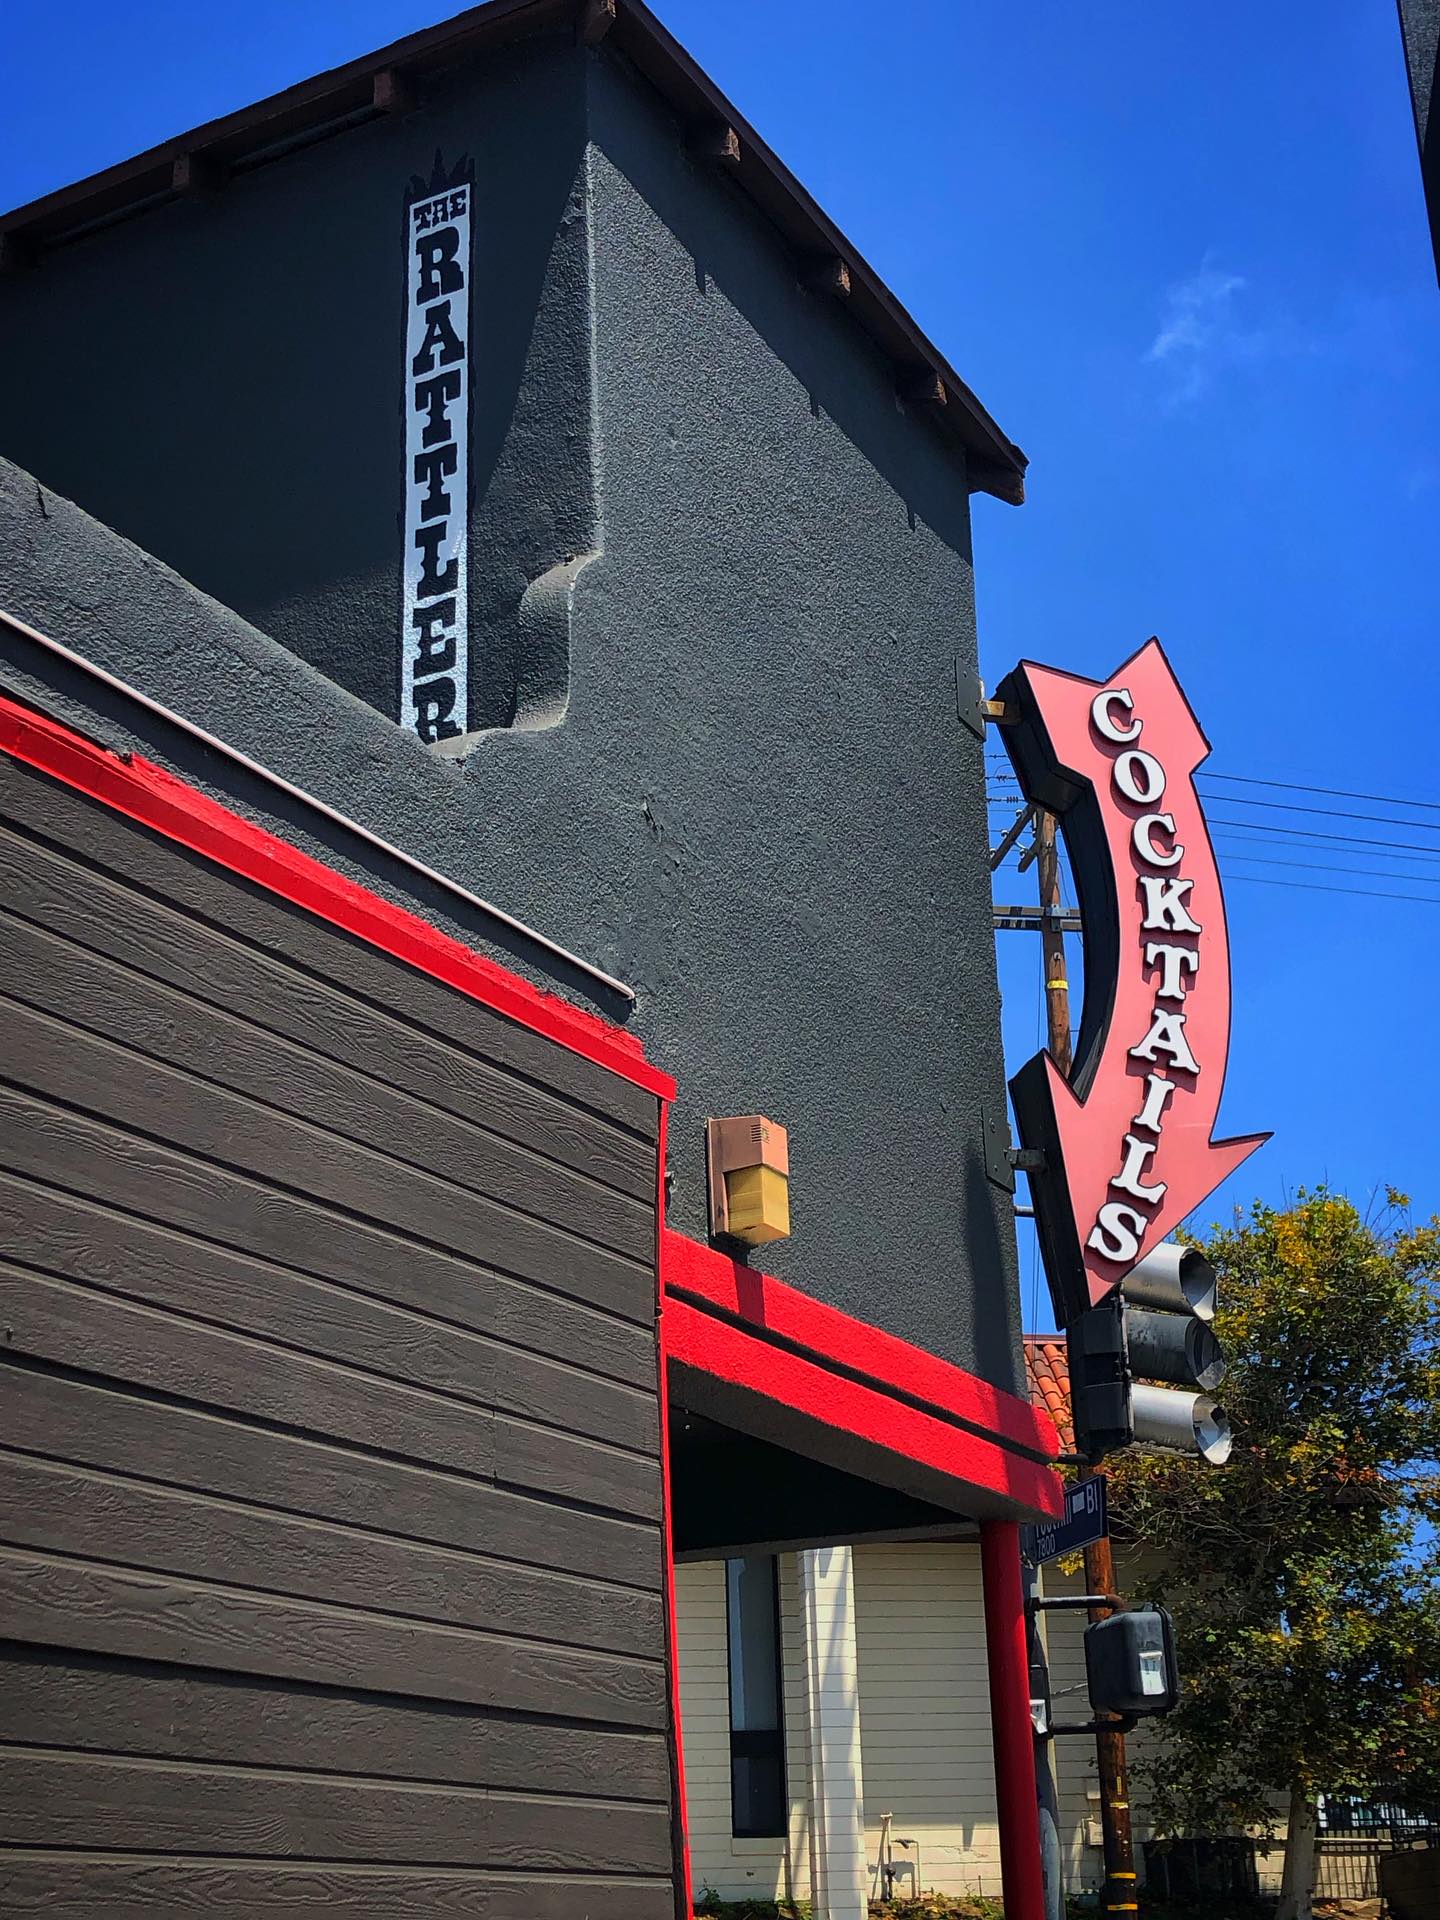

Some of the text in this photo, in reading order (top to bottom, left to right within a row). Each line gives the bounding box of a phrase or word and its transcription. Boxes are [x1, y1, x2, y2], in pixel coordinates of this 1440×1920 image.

[413, 188, 467, 234] THE
[412, 225, 465, 746] RATTLER
[1087, 688, 1201, 1262] COCKTAILS
